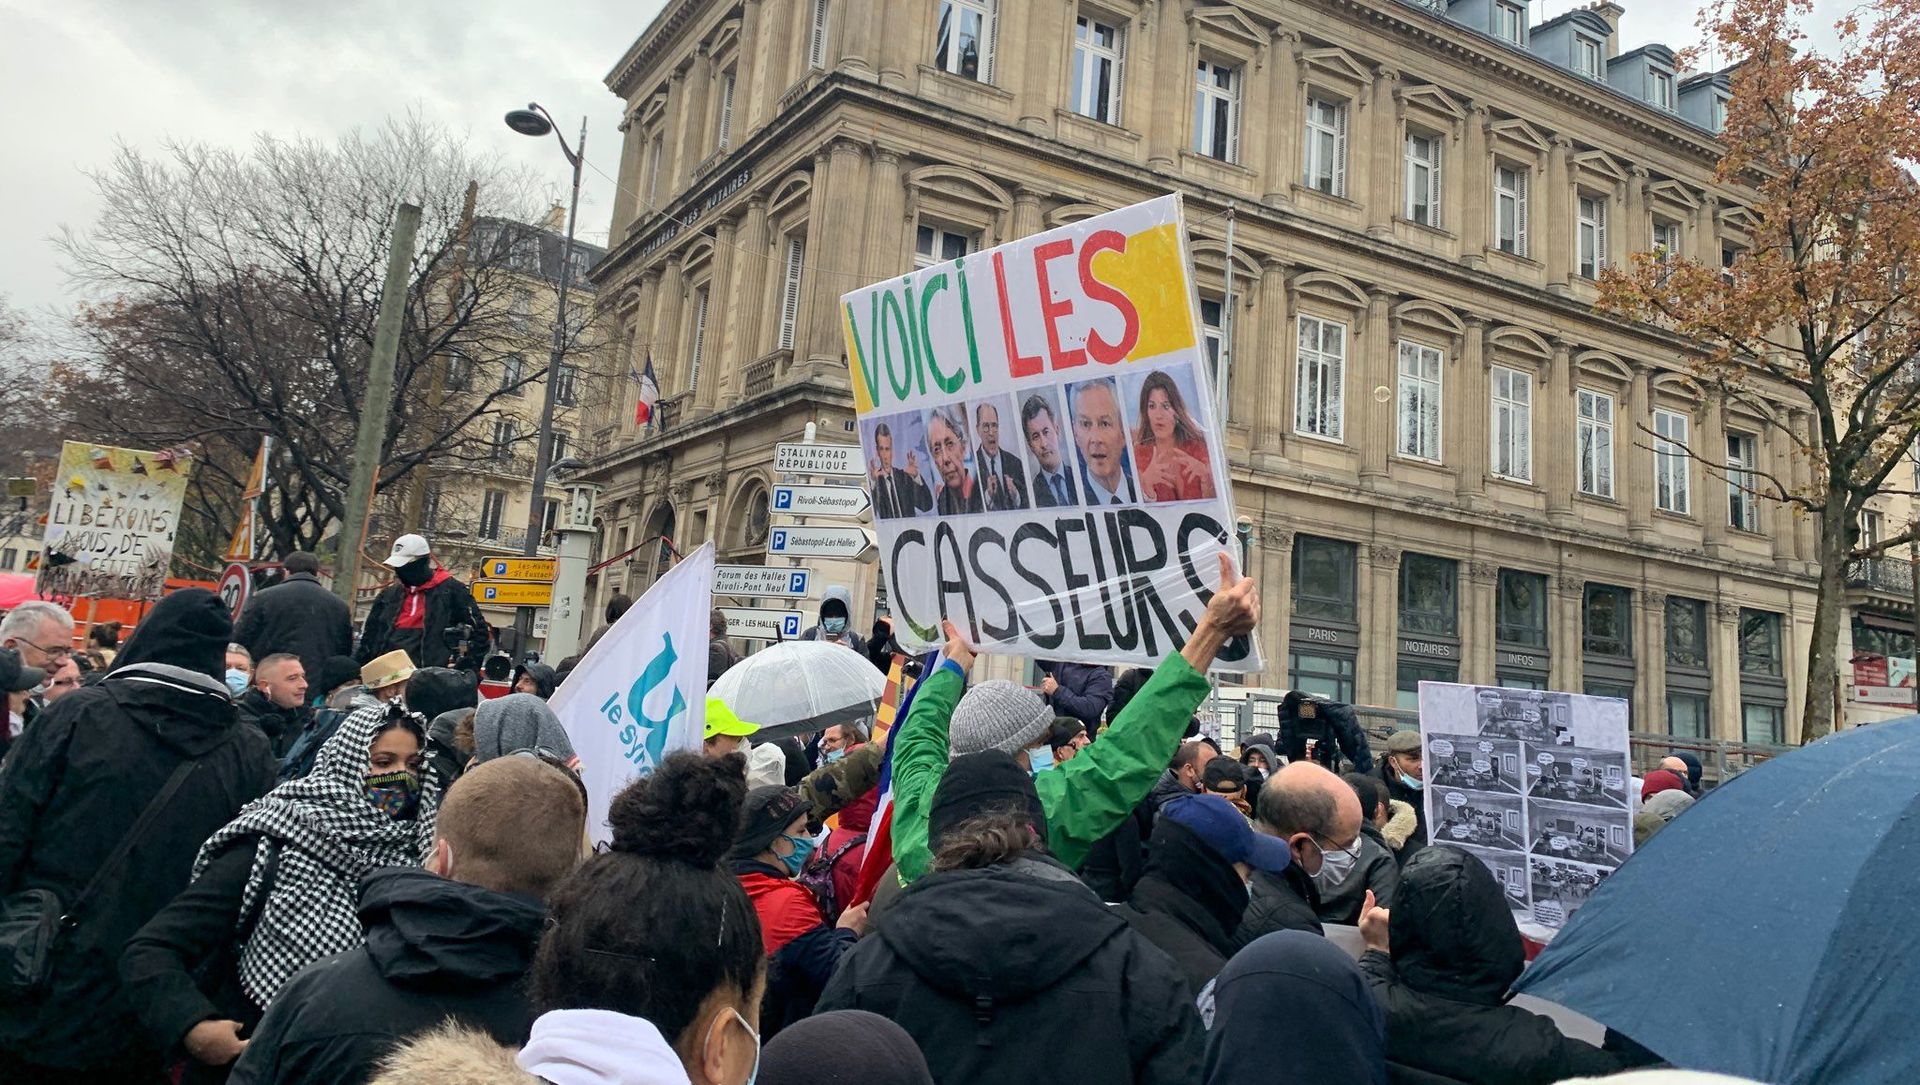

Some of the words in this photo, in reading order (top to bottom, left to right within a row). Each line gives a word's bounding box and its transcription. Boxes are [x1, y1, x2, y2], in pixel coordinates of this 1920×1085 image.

[706, 170, 749, 211] NOTAIRES
[991, 229, 1141, 379] LES
[780, 448, 848, 459] STALINGRAD
[778, 459, 848, 471] RÉPUBLIQUE
[797, 495, 858, 508] Rivoli-Sébastopol
[120, 533, 148, 556] DE
[836, 539, 856, 548] Halles
[717, 570, 742, 580] Forum
[744, 571, 758, 580] des
[760, 571, 786, 581] Halles
[716, 581, 762, 592] Rivoli-Pont
[765, 583, 786, 592] Neuf
[890, 508, 1251, 663] CASSEURS
[726, 618, 740, 626] GER
[745, 619, 757, 628] LES
[757, 620, 781, 629] HALLES
[1308, 628, 1338, 642] PARIS
[1405, 640, 1450, 656] NOTAIRES
[1508, 653, 1534, 666] INFOS
[600, 691, 622, 725] le
